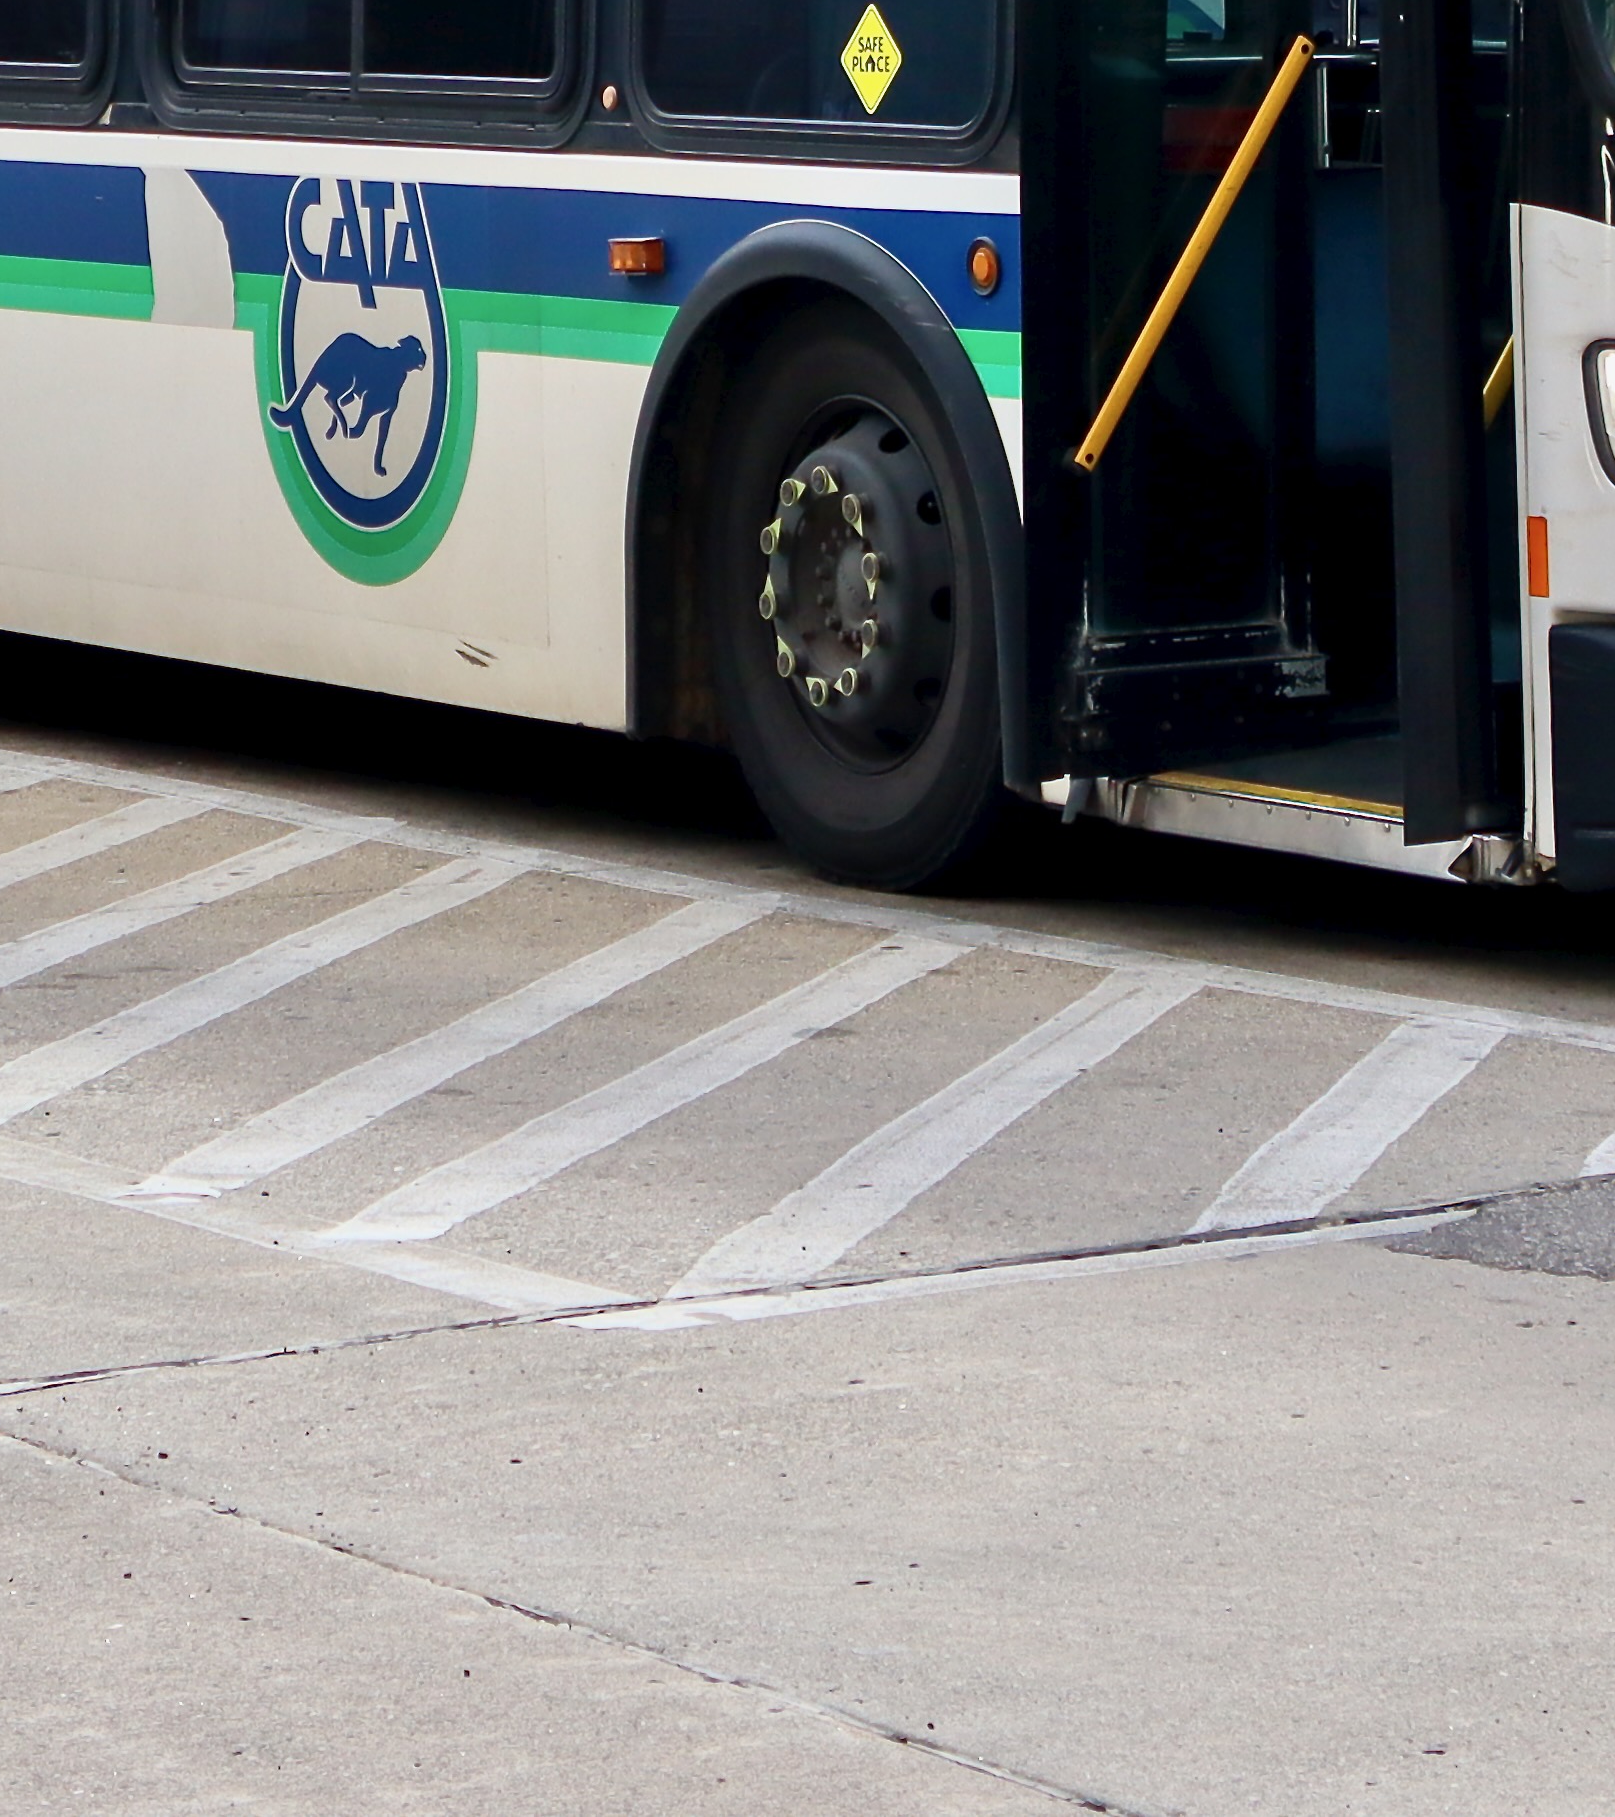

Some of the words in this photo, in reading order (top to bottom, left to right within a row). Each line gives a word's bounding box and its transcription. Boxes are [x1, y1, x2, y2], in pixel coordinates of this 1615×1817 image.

[857, 36, 884, 53] SAFE
[851, 54, 890, 73] PLACE
[285, 176, 444, 310] CATA
